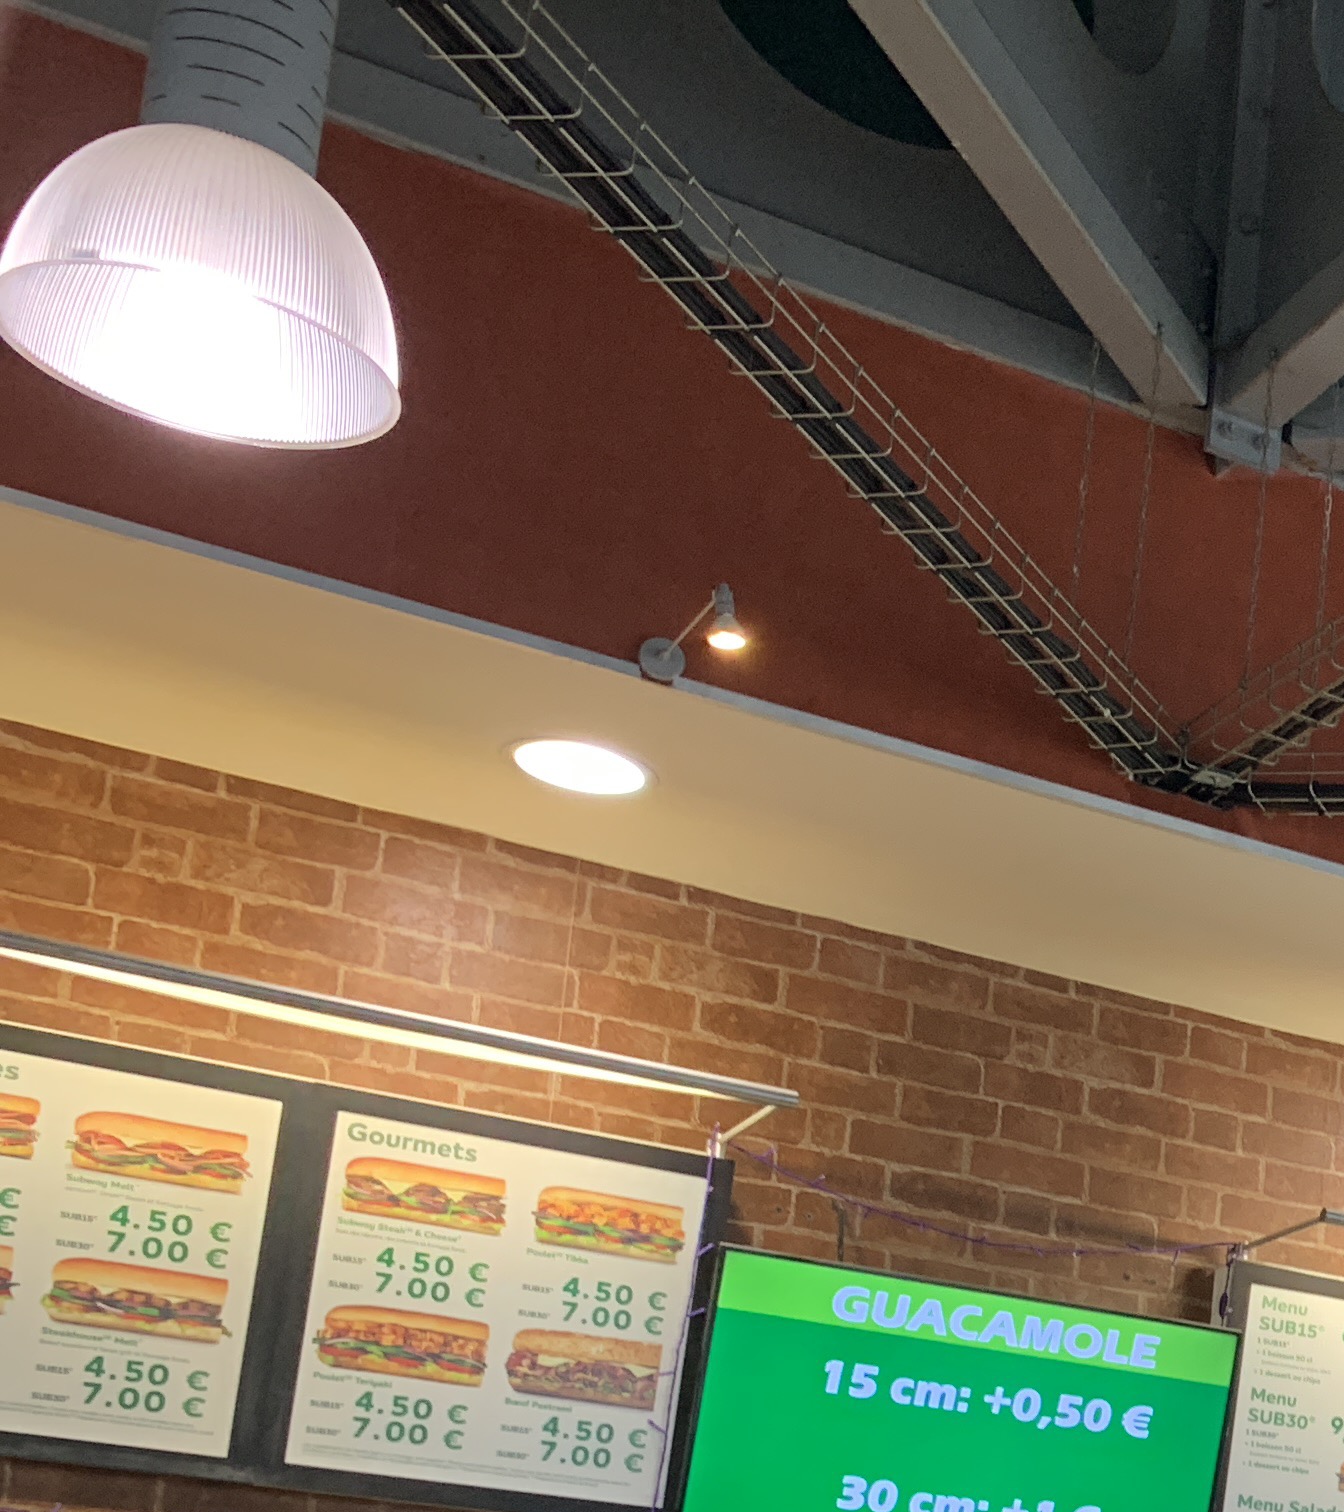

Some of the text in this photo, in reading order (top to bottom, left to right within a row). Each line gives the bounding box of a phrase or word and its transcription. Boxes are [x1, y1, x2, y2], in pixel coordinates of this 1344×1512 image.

[347, 1122, 477, 1162] Gourmets
[65, 1173, 107, 1188] Subway
[109, 1205, 193, 1237] 4.50
[209, 1221, 233, 1243] €
[337, 1216, 376, 1231] Subway
[107, 1231, 189, 1263] 7.00
[206, 1248, 229, 1269] €
[376, 1247, 454, 1277] 4.50
[469, 1262, 490, 1282] €
[375, 1271, 450, 1302] 7.00
[465, 1288, 486, 1307] €
[562, 1277, 633, 1305] 4.50
[648, 1291, 668, 1311] €
[1261, 1295, 1308, 1316] Menu
[562, 1300, 632, 1330] 7.00
[644, 1316, 664, 1335] €
[831, 1284, 1161, 1370] GUACAMOLE
[84, 1356, 169, 1386] 4.50
[187, 1370, 210, 1391] €
[83, 1381, 165, 1412] 7.00
[182, 1397, 206, 1418] €
[355, 1391, 432, 1420] 4.50
[447, 1404, 469, 1424] €
[823, 1360, 1154, 1439] 15 cm: +0,50 €
[1250, 1387, 1297, 1407] Menu
[352, 1416, 428, 1445] 7.00
[444, 1430, 464, 1450] €
[542, 1416, 614, 1444] 4.50
[628, 1429, 648, 1449] €
[540, 1440, 611, 1468] 7.00
[624, 1453, 644, 1473] €
[1237, 1494, 1284, 1512] Menu
